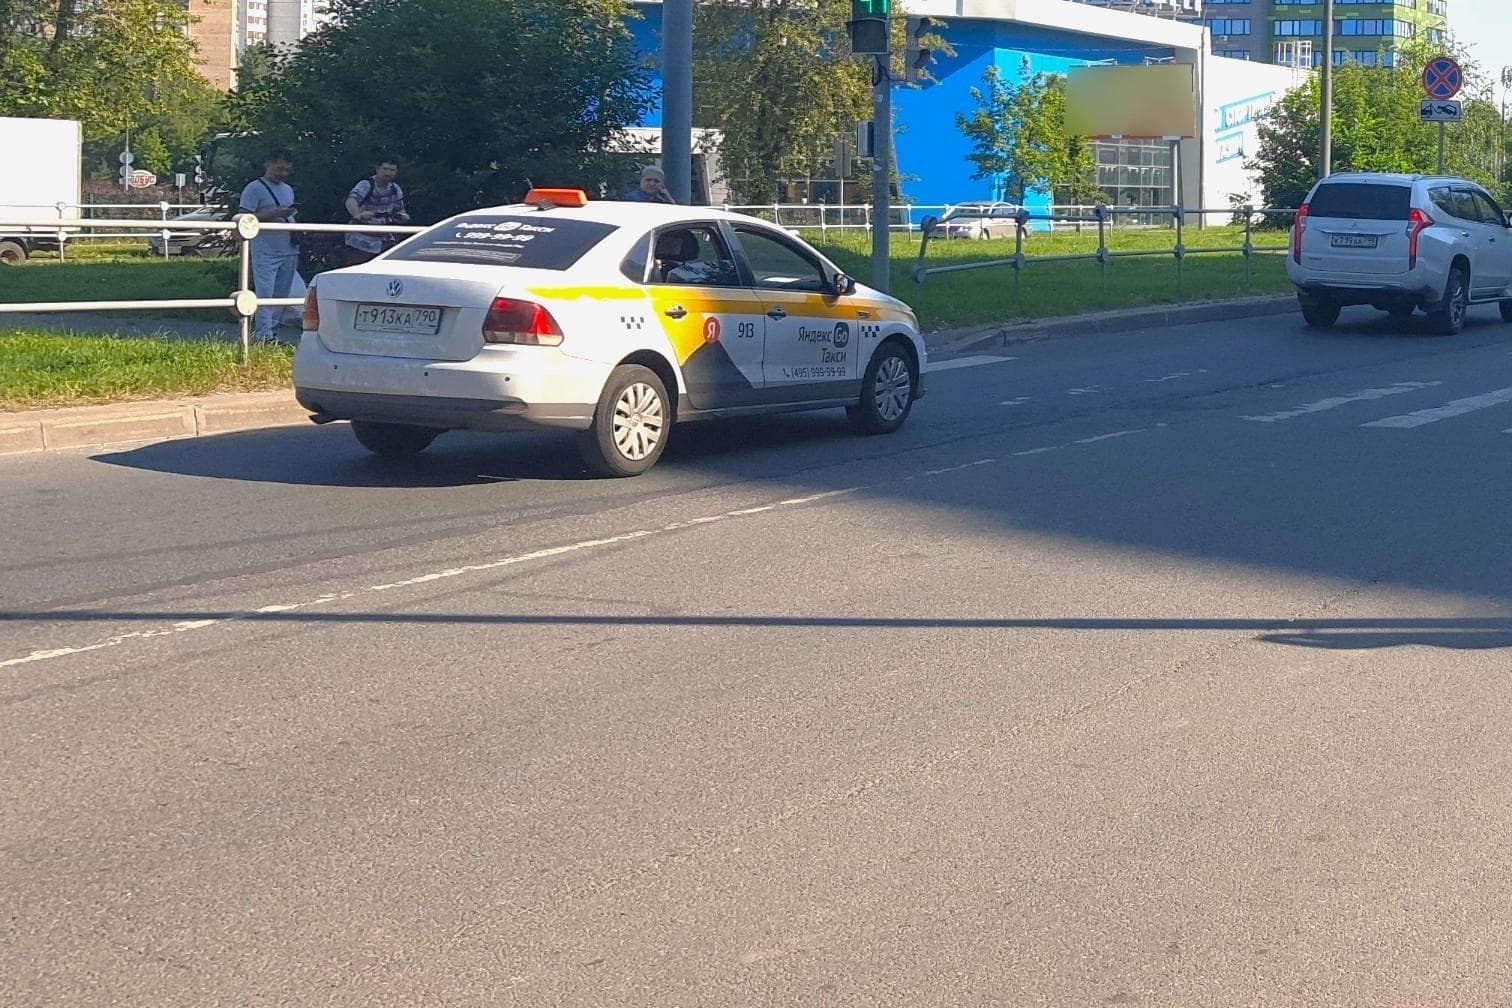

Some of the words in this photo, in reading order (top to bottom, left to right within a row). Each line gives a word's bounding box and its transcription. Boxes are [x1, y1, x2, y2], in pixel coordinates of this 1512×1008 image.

[361, 308, 411, 326] Т913КА
[415, 309, 437, 322] 790
[707, 322, 716, 339] Я
[737, 322, 755, 338] 913
[798, 325, 832, 343] Яндекс
[834, 326, 849, 343] Go
[821, 347, 847, 364] Такси
[791, 368, 810, 379] (495)
[811, 367, 846, 377] 999-99-99
